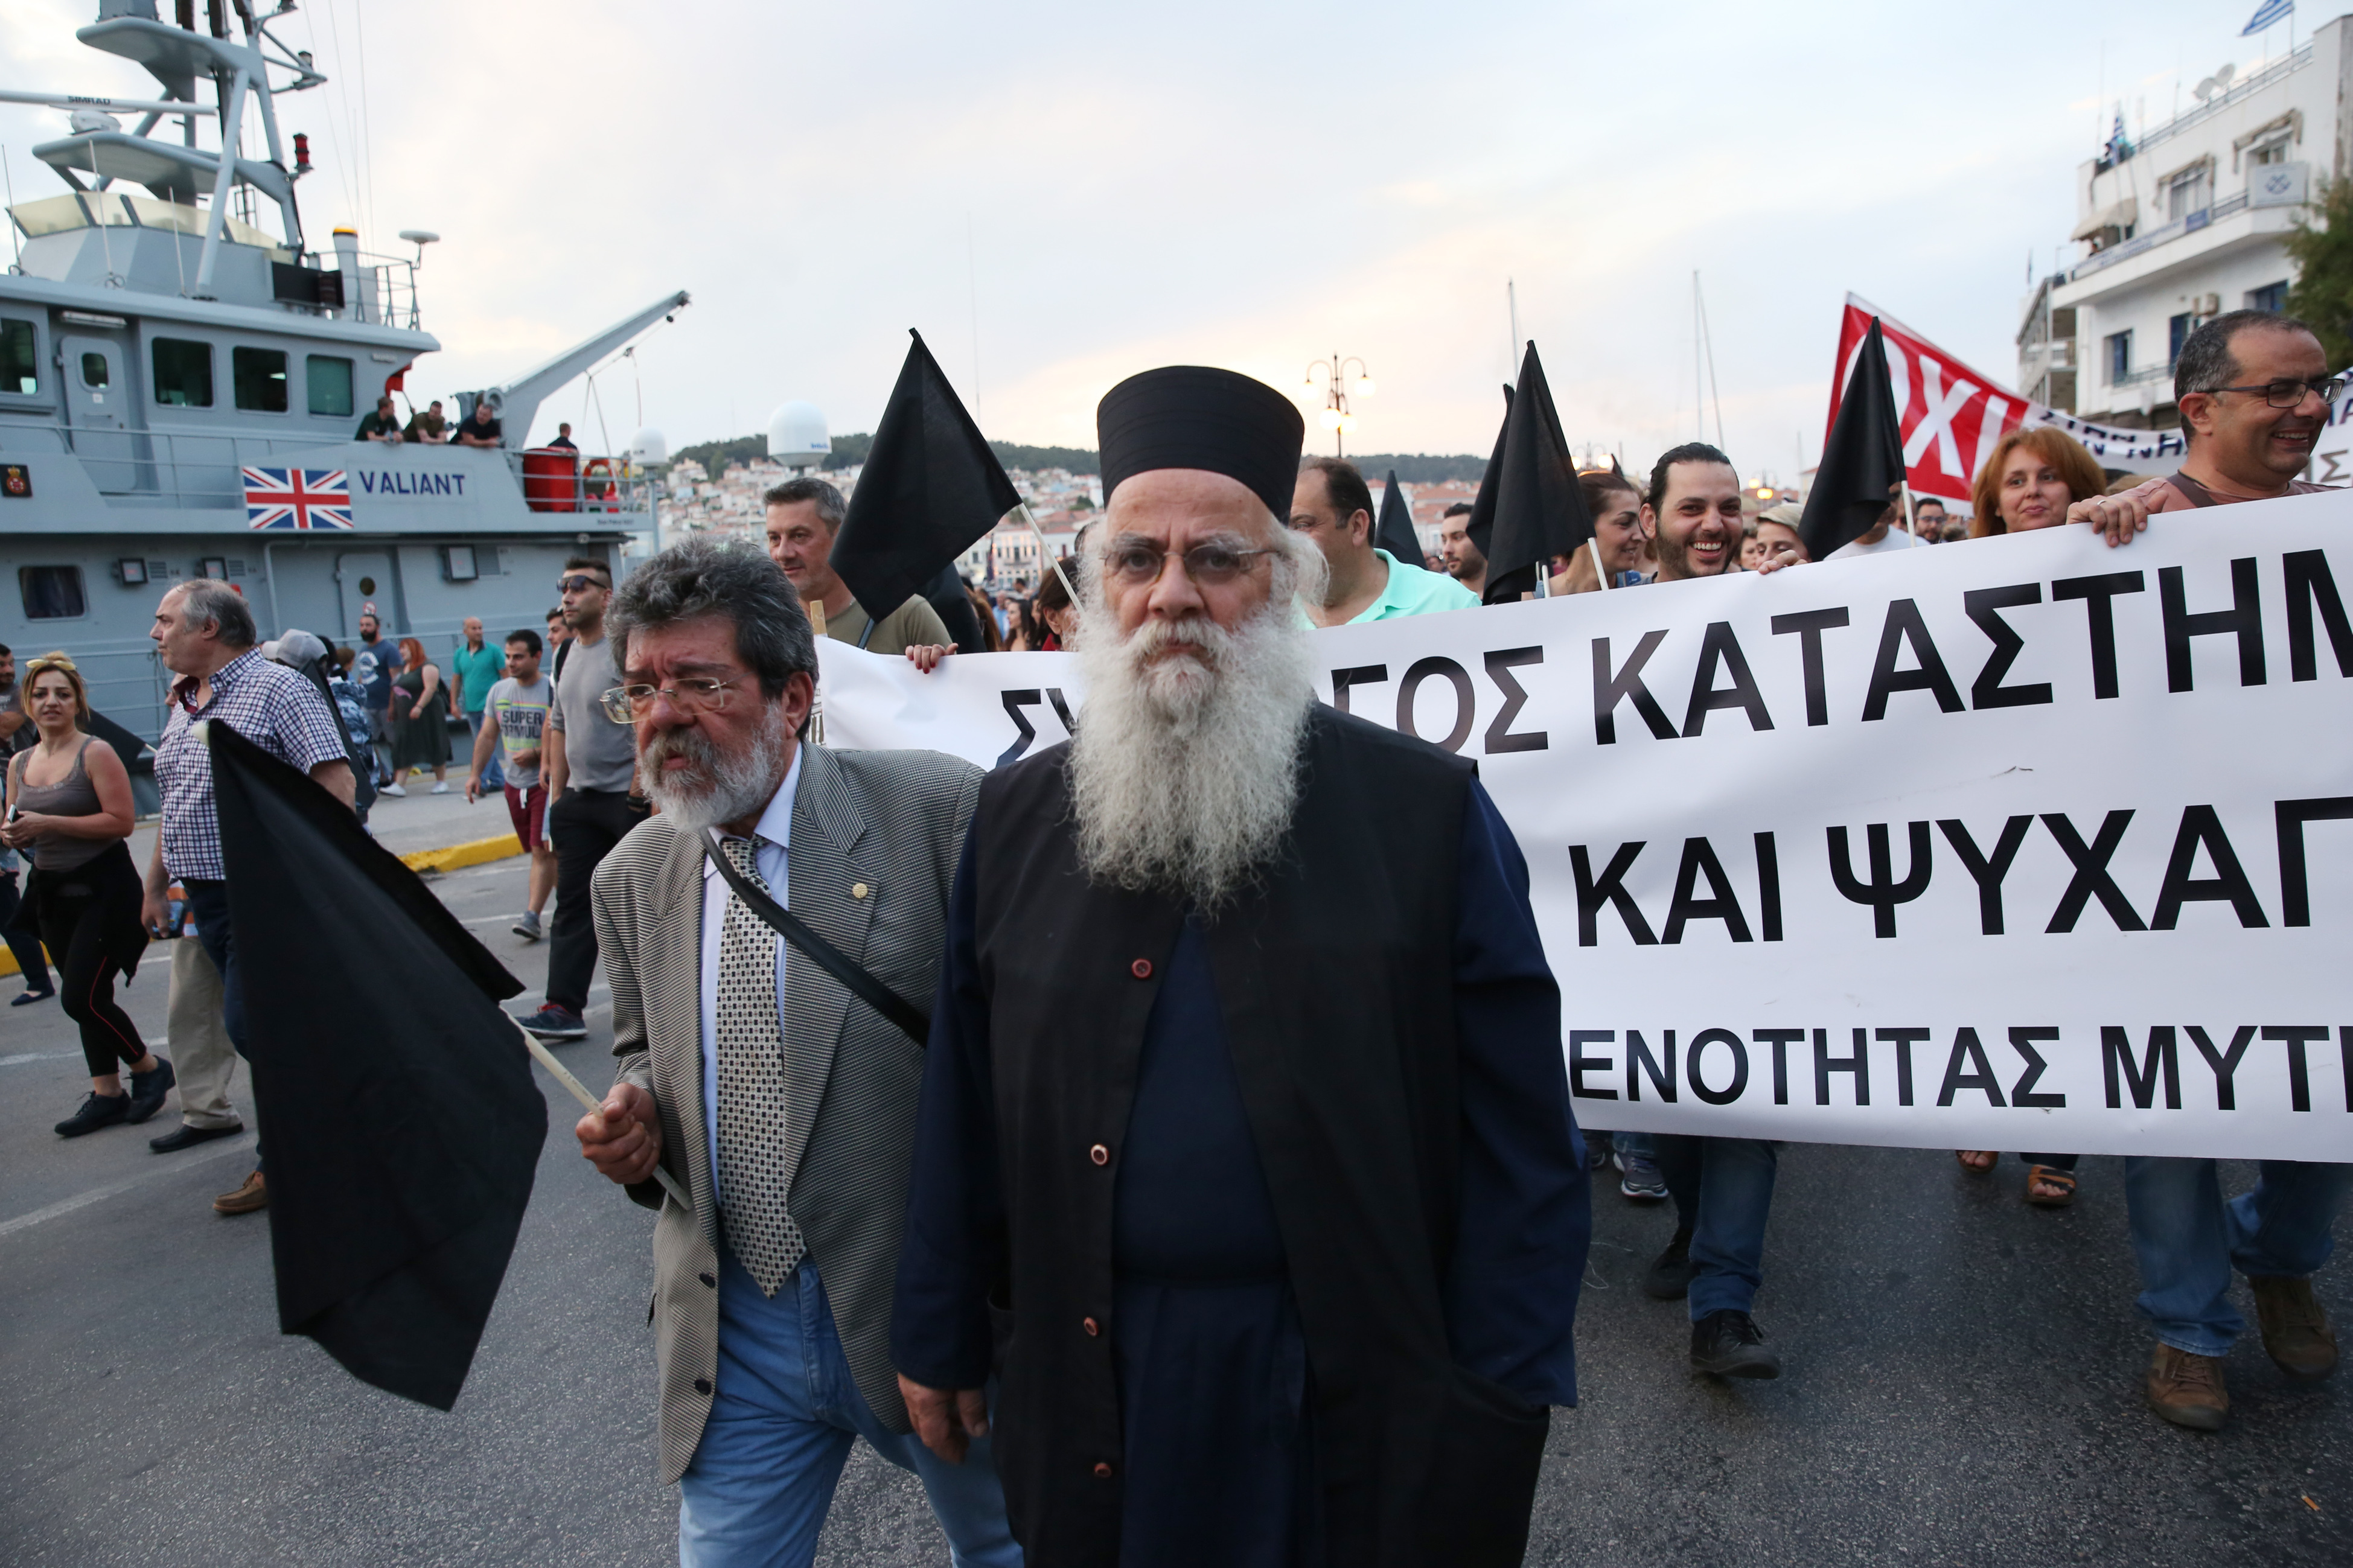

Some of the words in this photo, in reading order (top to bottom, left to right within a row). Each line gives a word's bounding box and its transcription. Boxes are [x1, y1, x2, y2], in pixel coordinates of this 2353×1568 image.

[359, 470, 465, 495] VALIANT
[502, 711, 542, 725] SUPER
[1568, 831, 1783, 947] ΚΑΙ
[1569, 1026, 2066, 1108] ΕΝΟΤΗΤΑΣ
